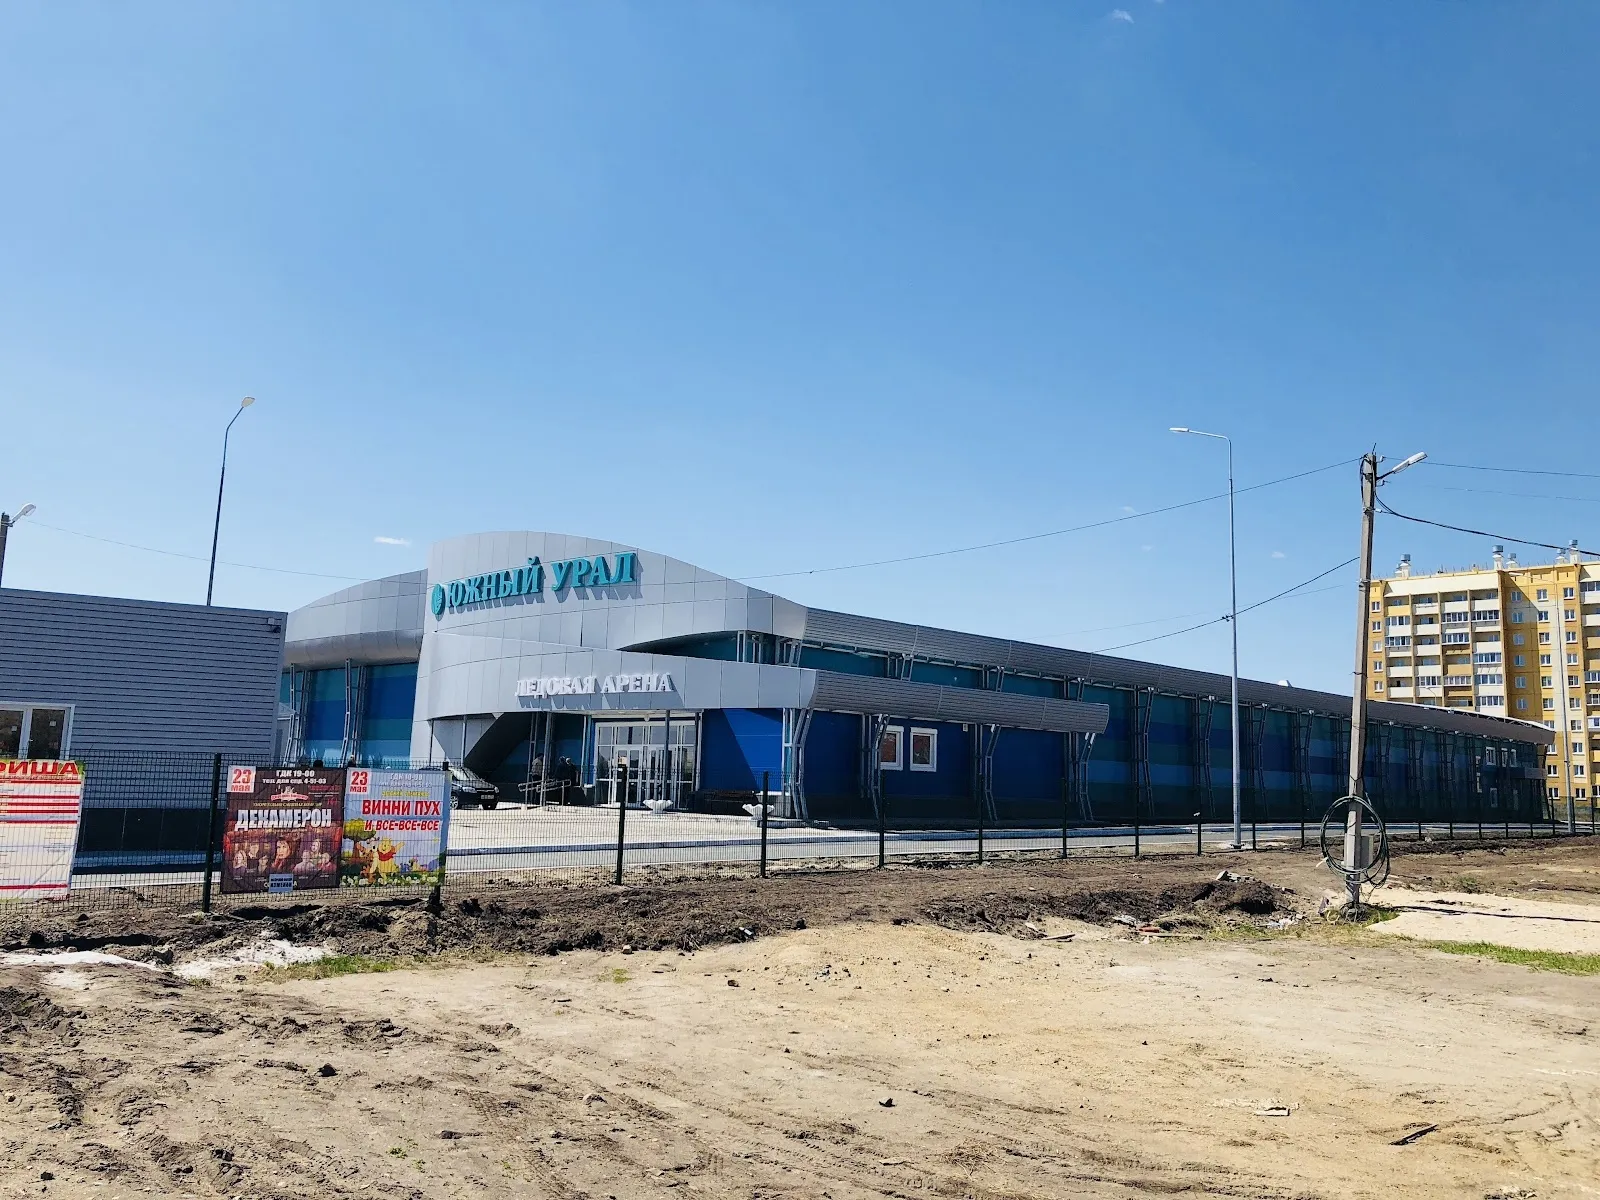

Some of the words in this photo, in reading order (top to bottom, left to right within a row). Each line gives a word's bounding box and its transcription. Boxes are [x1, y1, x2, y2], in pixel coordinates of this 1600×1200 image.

[446, 556, 542, 607] ЮЖНЫЙ
[551, 552, 636, 591] УРАЛ
[515, 675, 596, 699] ЛЕДОВАЯ
[600, 673, 673, 692] АРЕНА
[233, 769, 252, 784] 23
[351, 771, 368, 786] 23
[362, 800, 411, 815] ВИННИ
[414, 801, 440, 815] ПУХ
[234, 809, 332, 831] ДЕКАМЕРОН
[364, 820, 373, 831] И
[375, 820, 440, 831] ВСЕ-ВСЕ-ВСЕ
